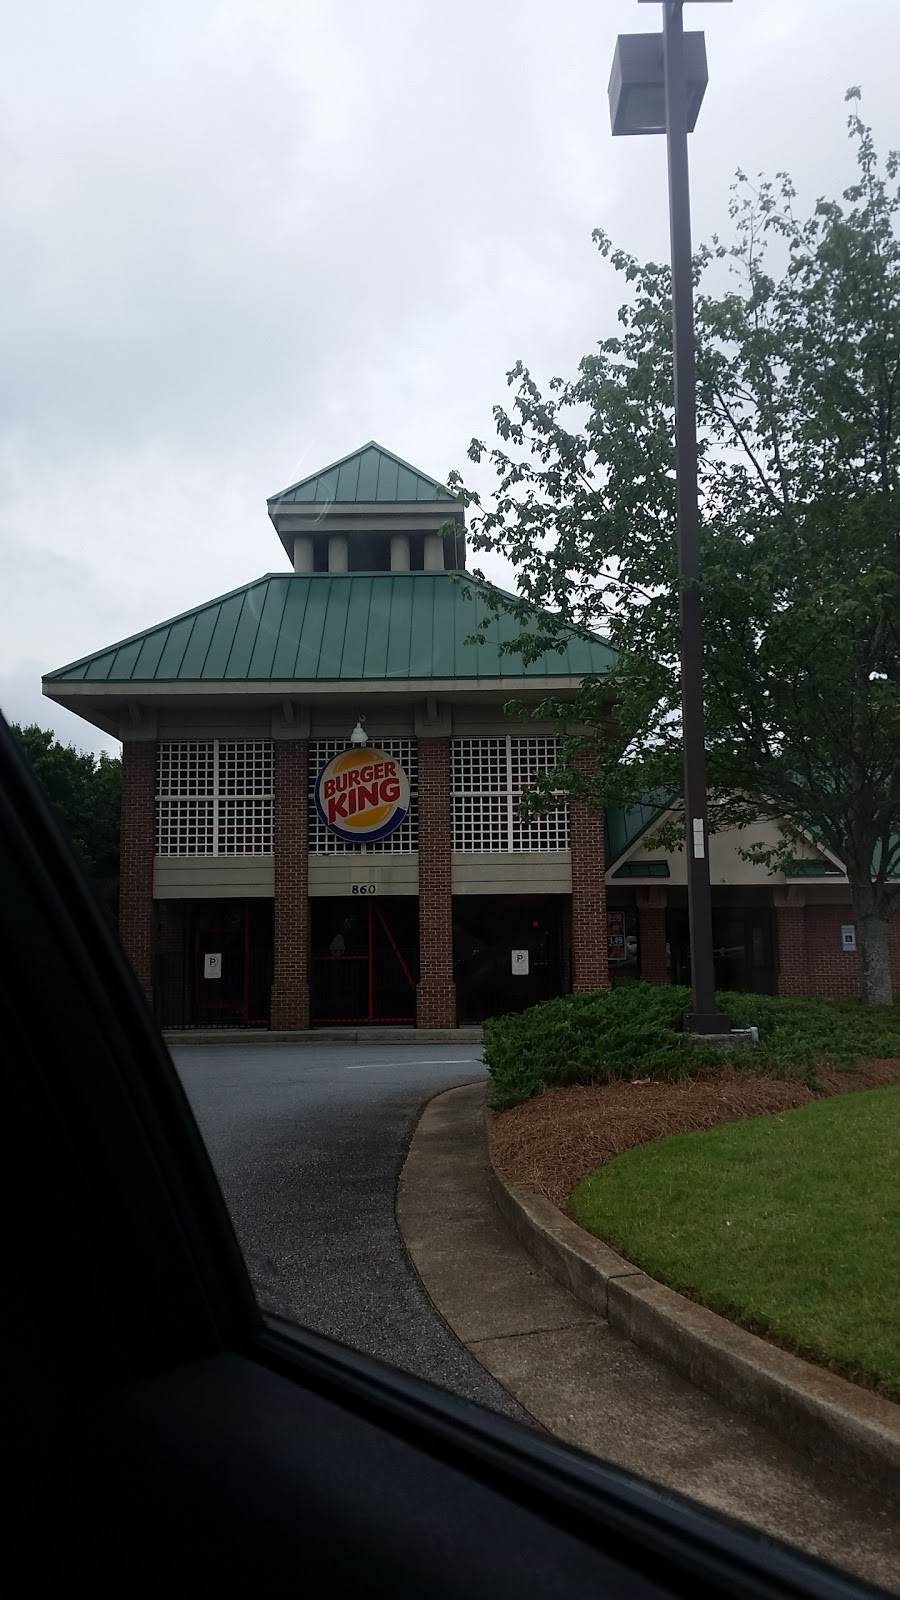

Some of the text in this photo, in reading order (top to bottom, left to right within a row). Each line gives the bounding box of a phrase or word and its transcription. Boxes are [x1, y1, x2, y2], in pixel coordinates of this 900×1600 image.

[324, 761, 397, 800] BURGER
[328, 777, 401, 823] KING
[351, 884, 376, 895] 860
